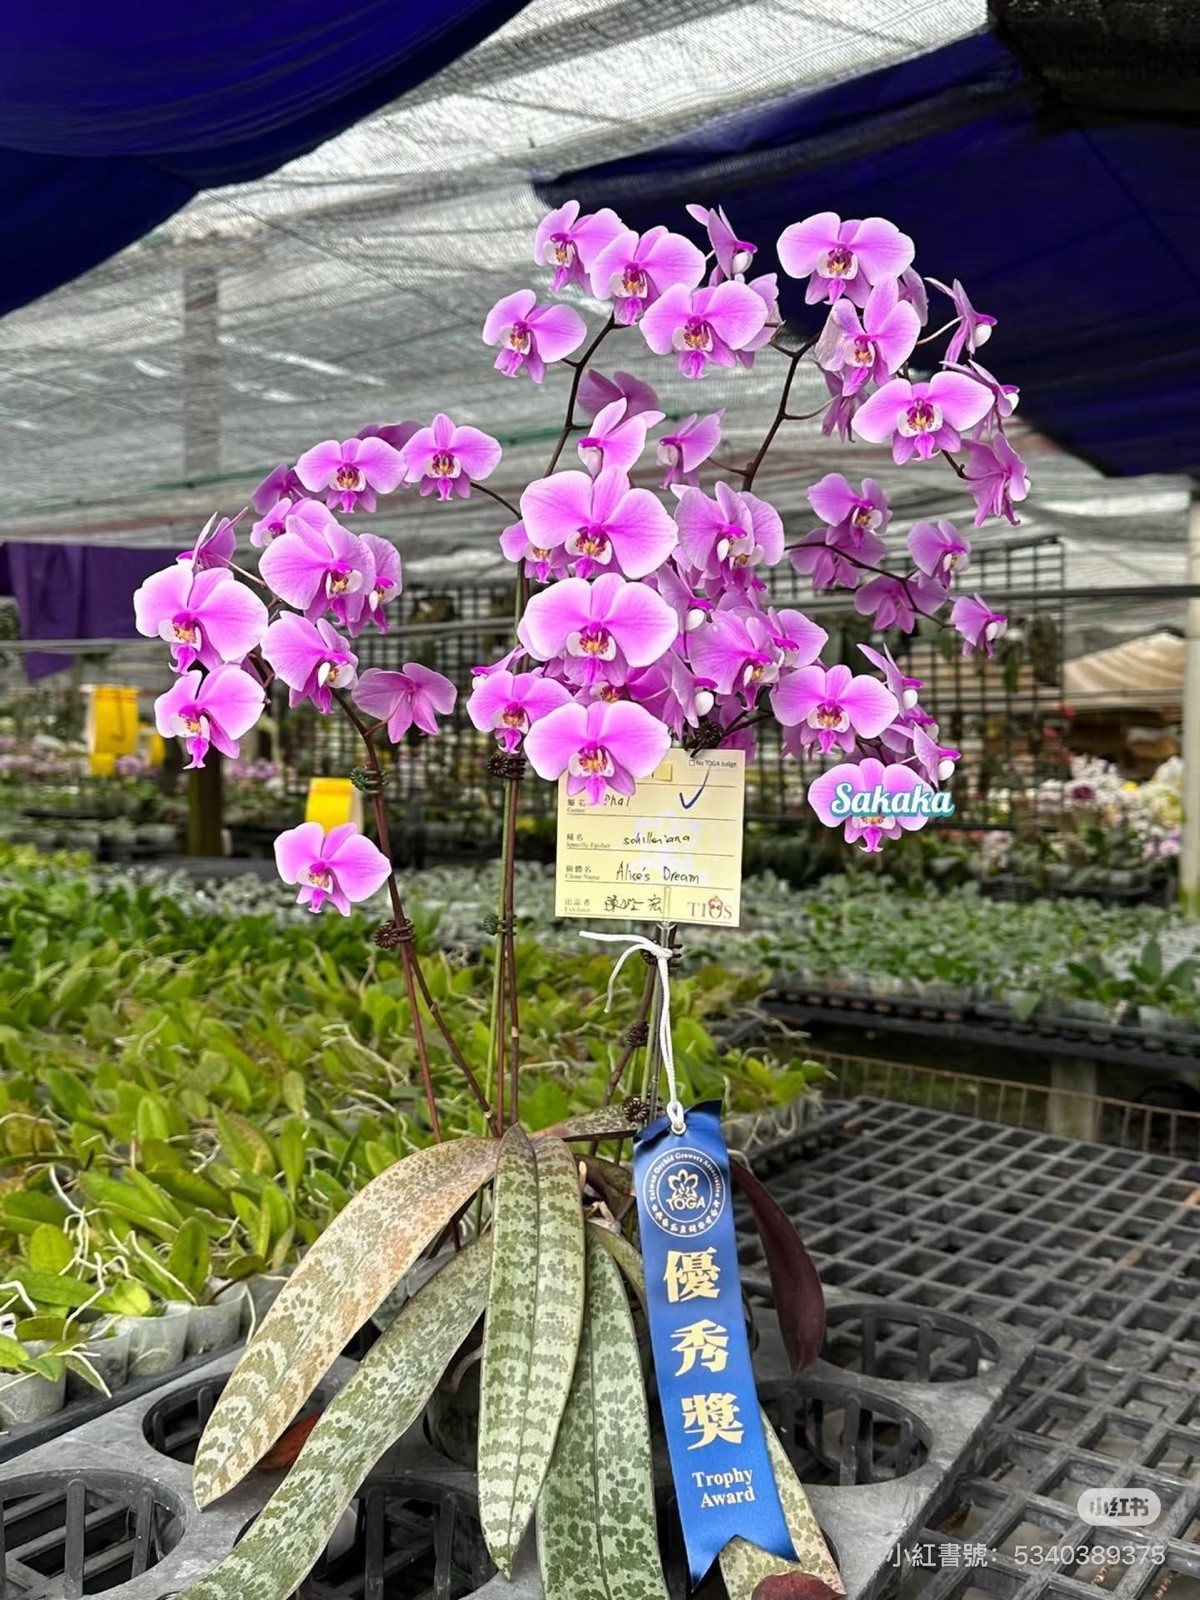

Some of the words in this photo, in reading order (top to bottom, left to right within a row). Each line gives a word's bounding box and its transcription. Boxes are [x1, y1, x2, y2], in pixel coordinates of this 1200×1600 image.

[615, 860, 651, 881] Alice's
[662, 865, 700, 884] Dream
[675, 1152, 703, 1164] Growers
[665, 1196, 706, 1212] TOGA
[691, 1467, 754, 1488] Trophy
[700, 1486, 756, 1509] Award
